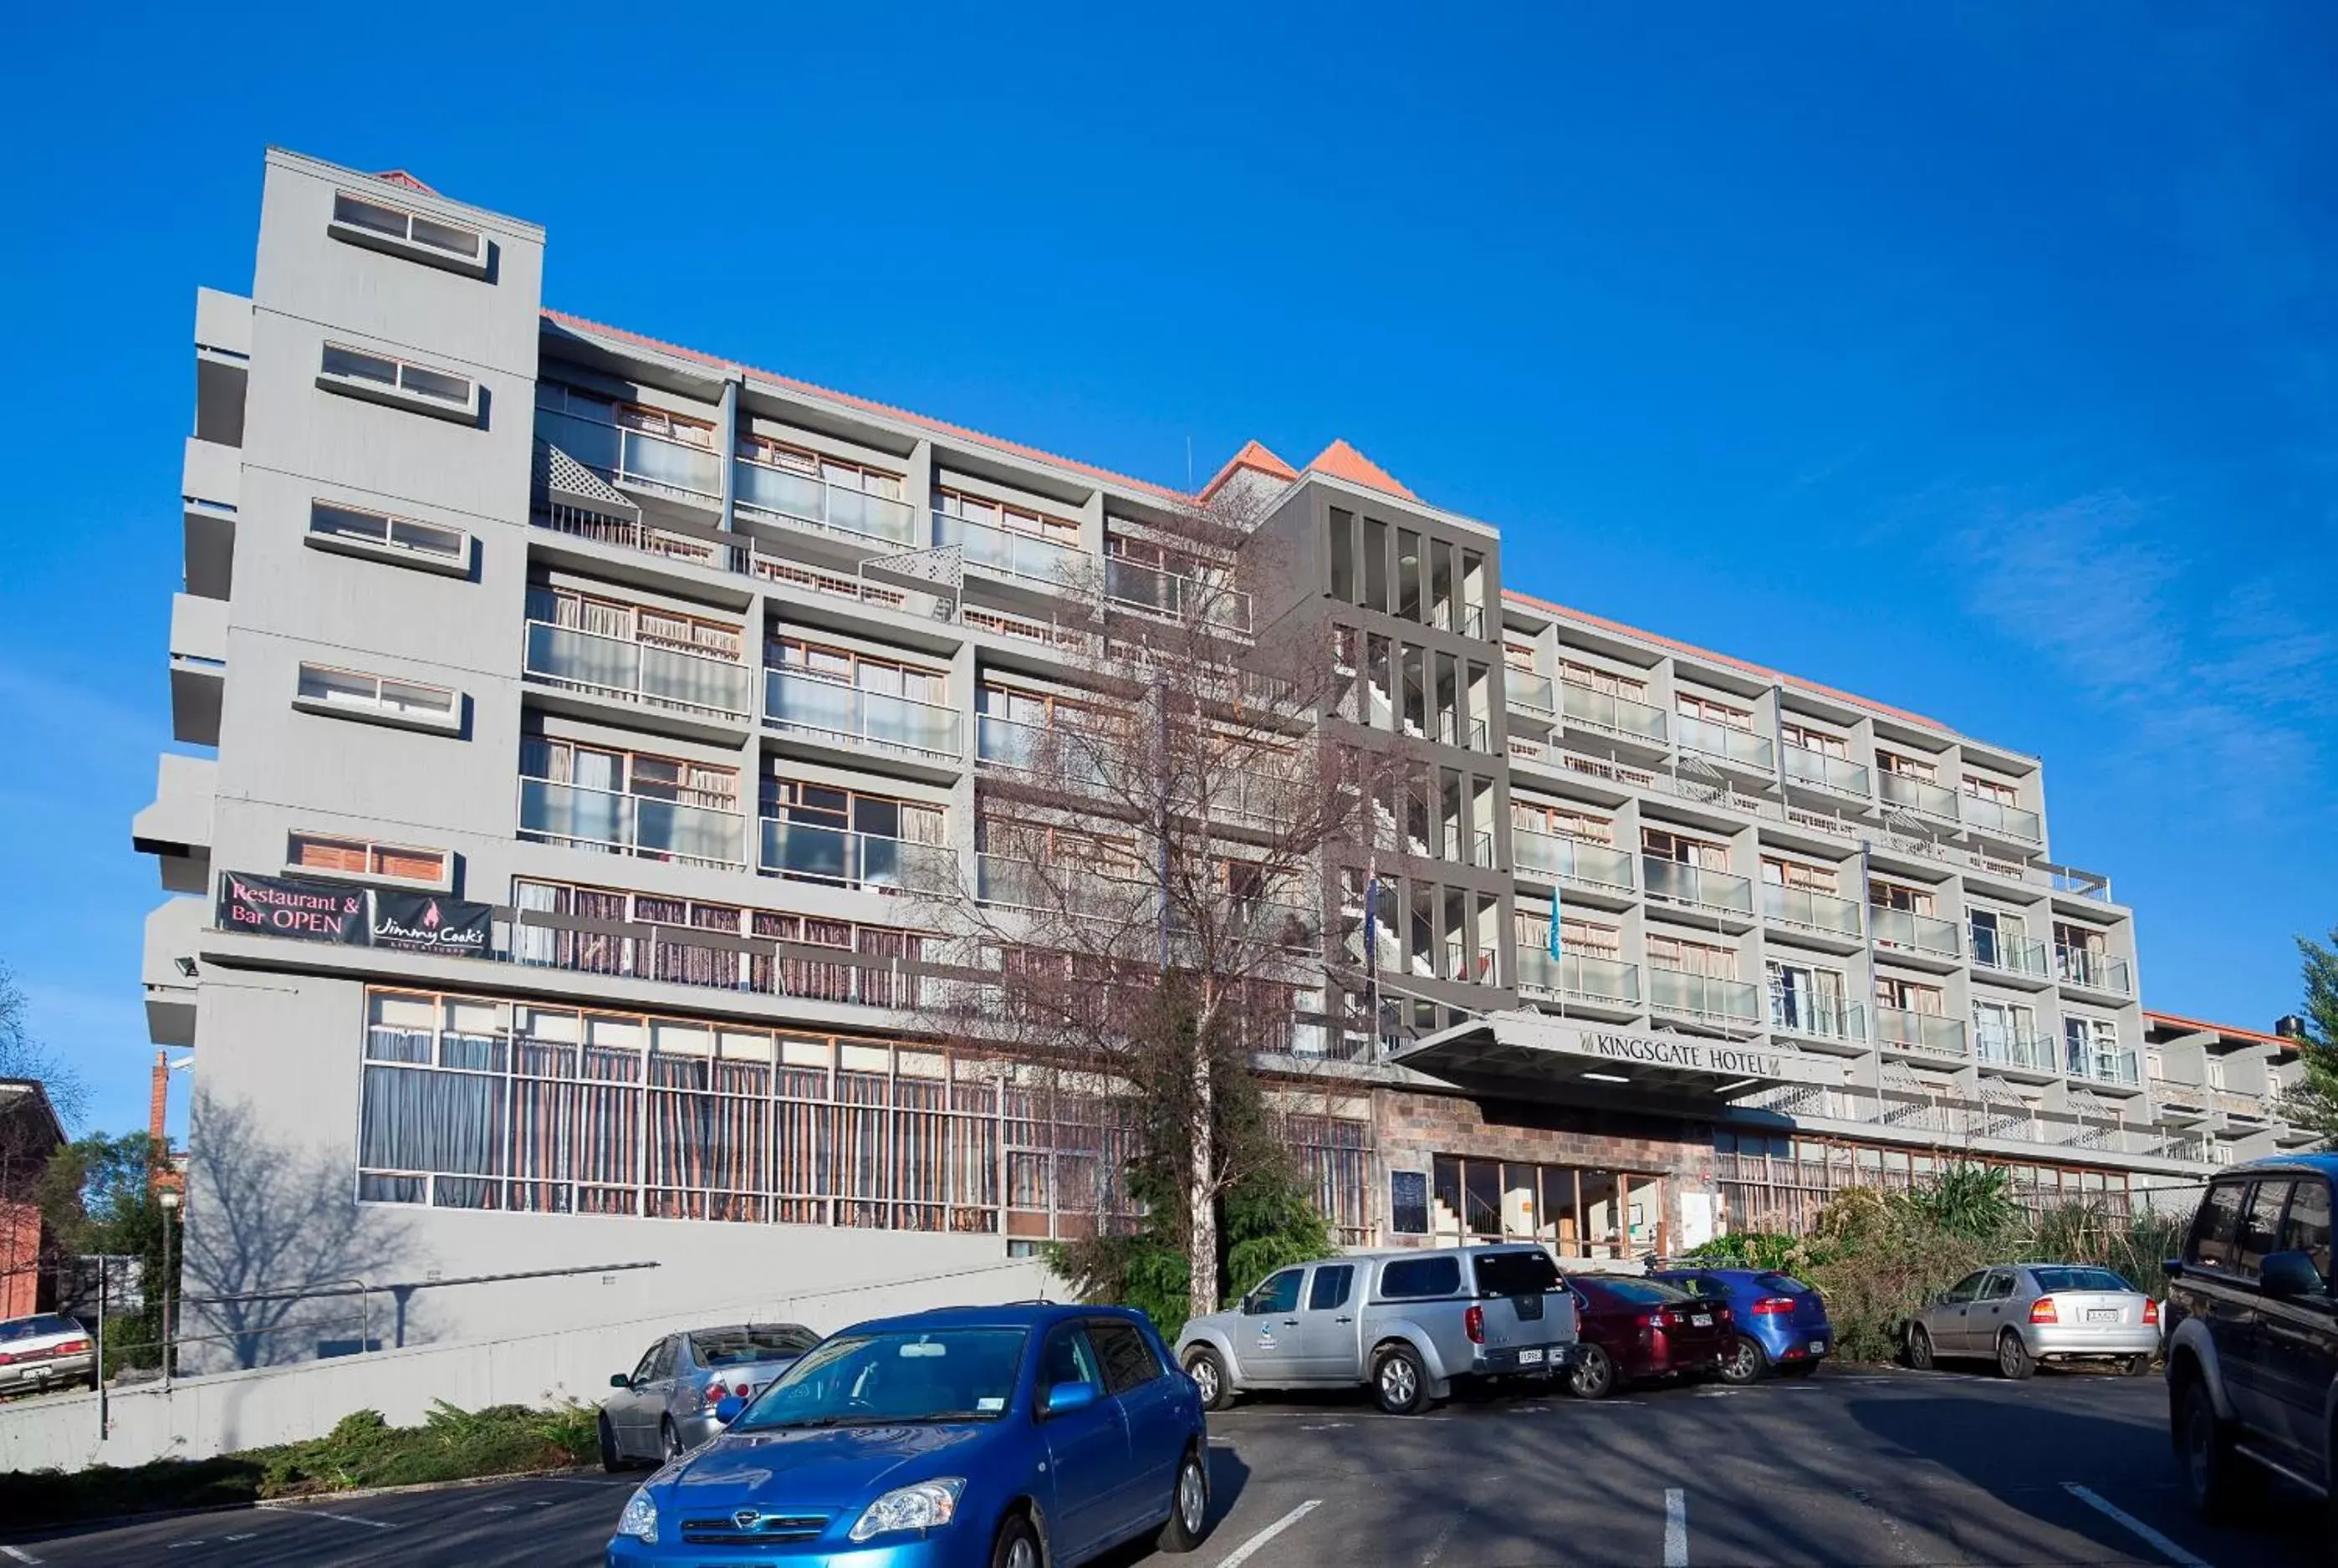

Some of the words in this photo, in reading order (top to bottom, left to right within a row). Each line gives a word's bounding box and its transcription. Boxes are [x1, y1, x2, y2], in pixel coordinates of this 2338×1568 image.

[232, 882, 338, 911] Restaurant
[344, 897, 360, 914] &
[232, 905, 265, 925] Bar
[273, 910, 343, 934] OPEN
[374, 917, 437, 946] Jimmy
[441, 927, 485, 943] Cook's
[1597, 1034, 1703, 1067] KINGSGATE
[1710, 1050, 1767, 1075] HOTEL
